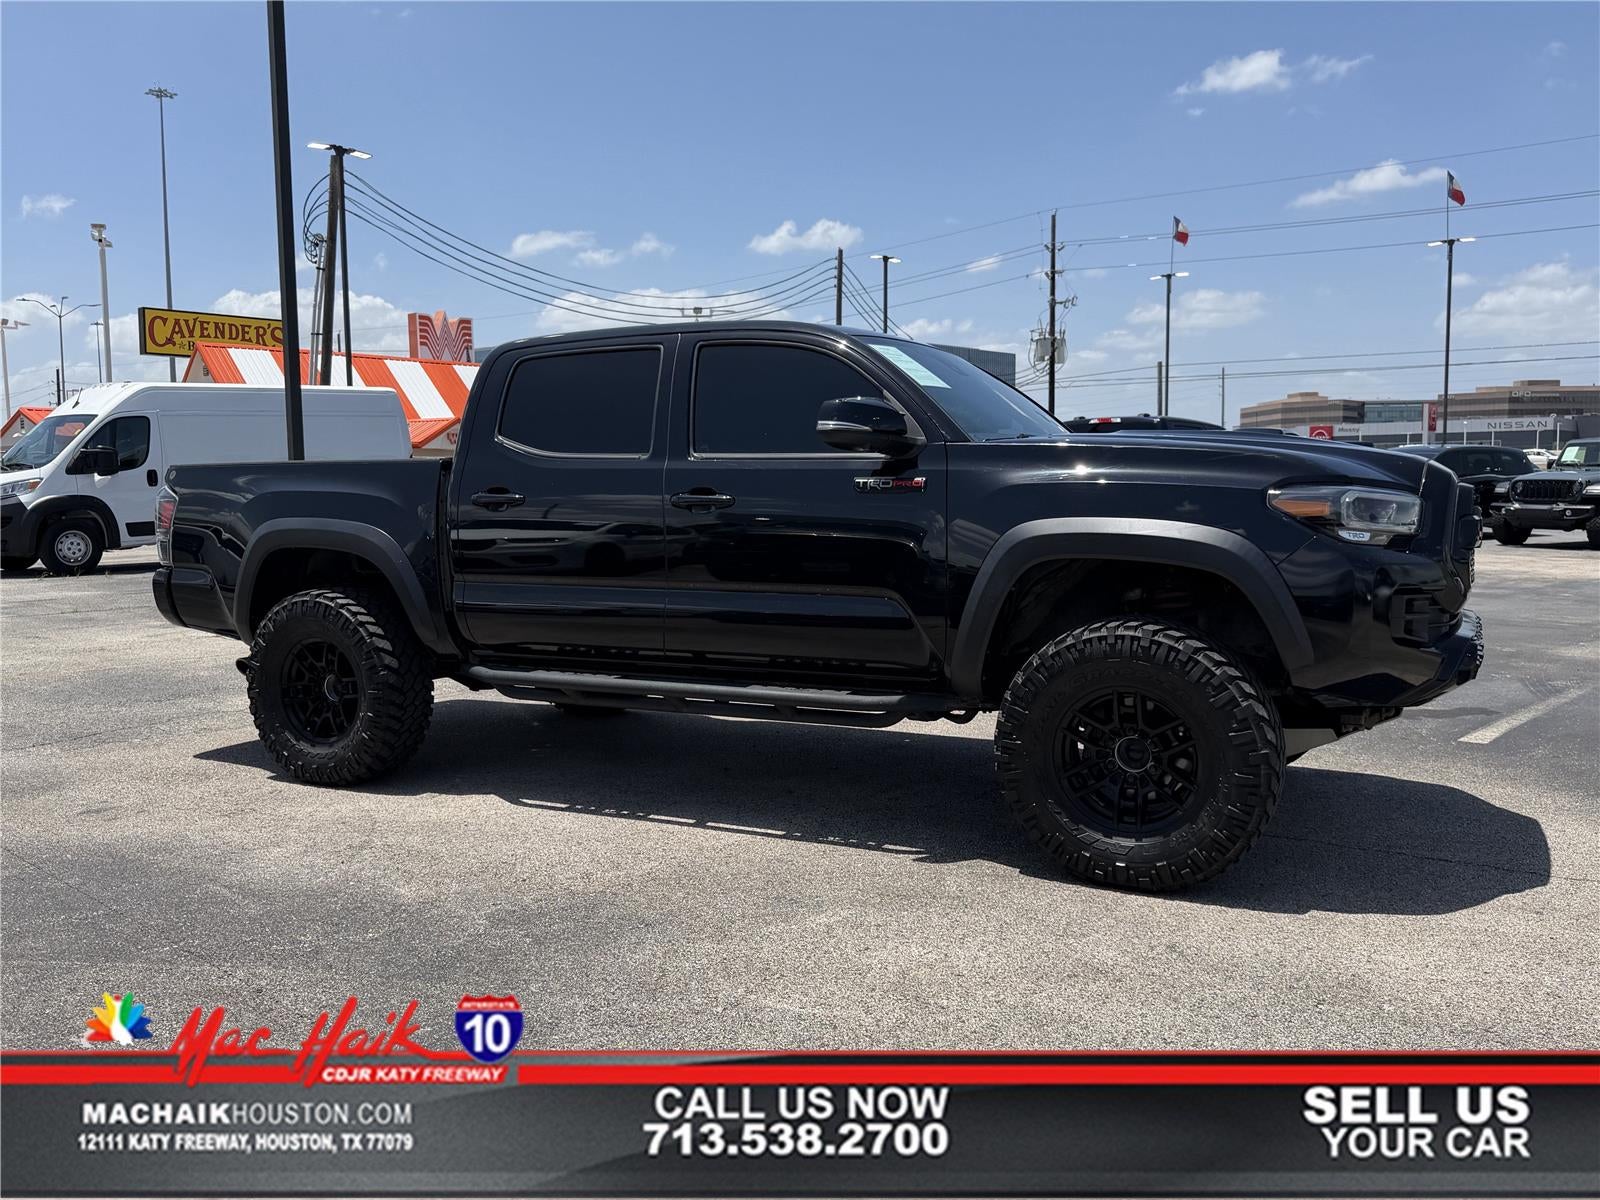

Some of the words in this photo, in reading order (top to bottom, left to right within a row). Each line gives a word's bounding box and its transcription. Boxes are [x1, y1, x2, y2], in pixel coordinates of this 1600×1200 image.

[147, 315, 284, 347] CAVENDER'S
[1487, 420, 1548, 430] NISSAN
[1346, 531, 1365, 539] TRD
